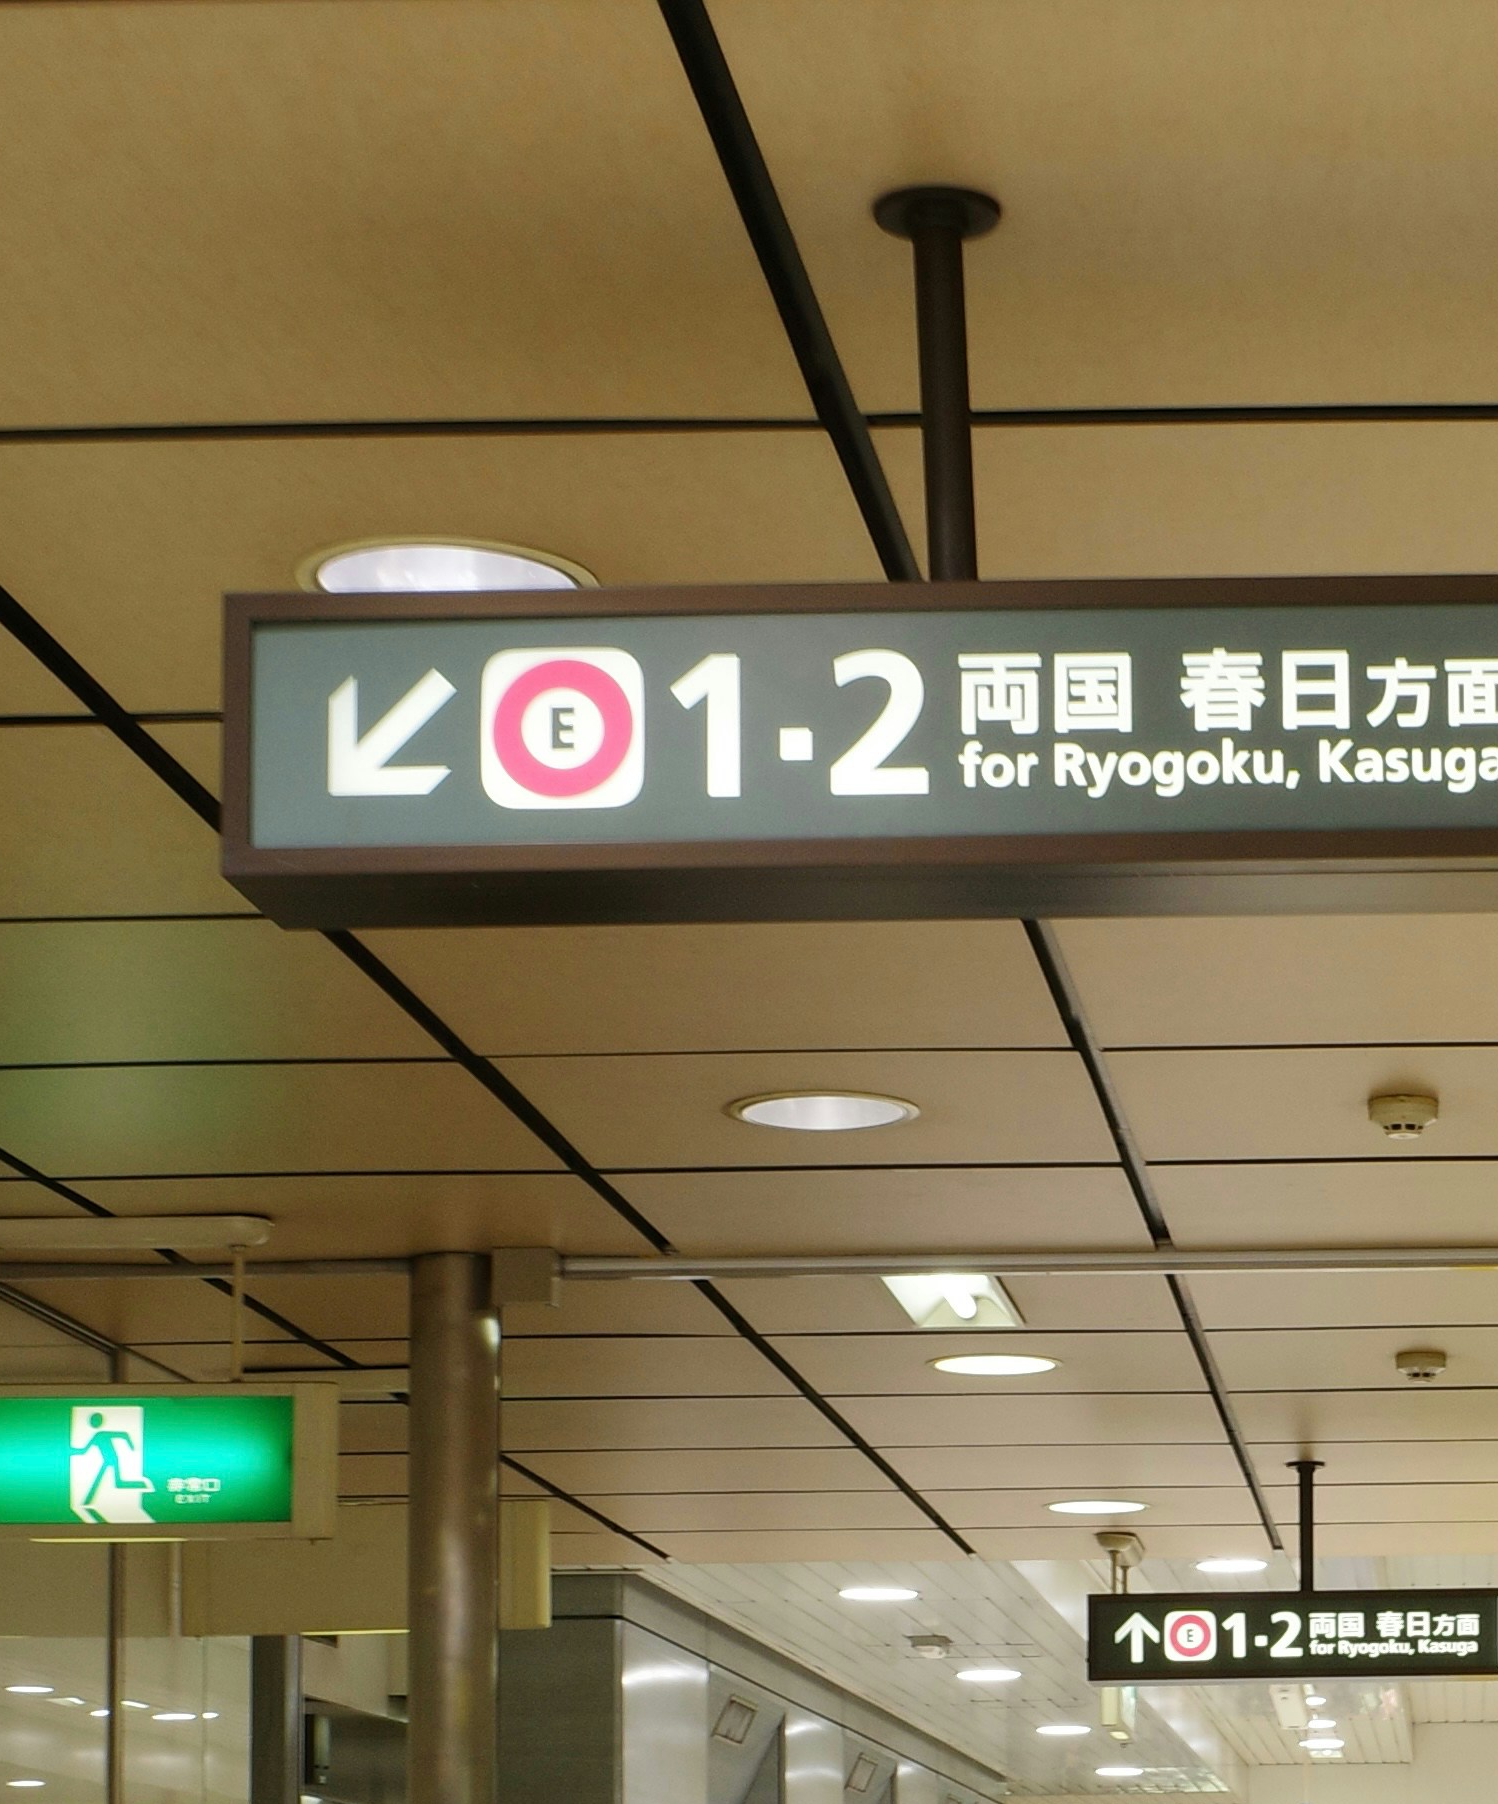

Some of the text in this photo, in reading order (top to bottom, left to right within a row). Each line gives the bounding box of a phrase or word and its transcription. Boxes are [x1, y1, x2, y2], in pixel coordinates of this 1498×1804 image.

[958, 653, 1132, 735] 両国
[552, 708, 574, 749] E
[958, 741, 1038, 787] for
[1054, 738, 1300, 795] Ryogoku,
[1187, 1629, 1193, 1642] E
[1309, 1611, 1479, 1638] 両国 春日方面
[1309, 1639, 1478, 1657] for Ryogoku, Kasuga
